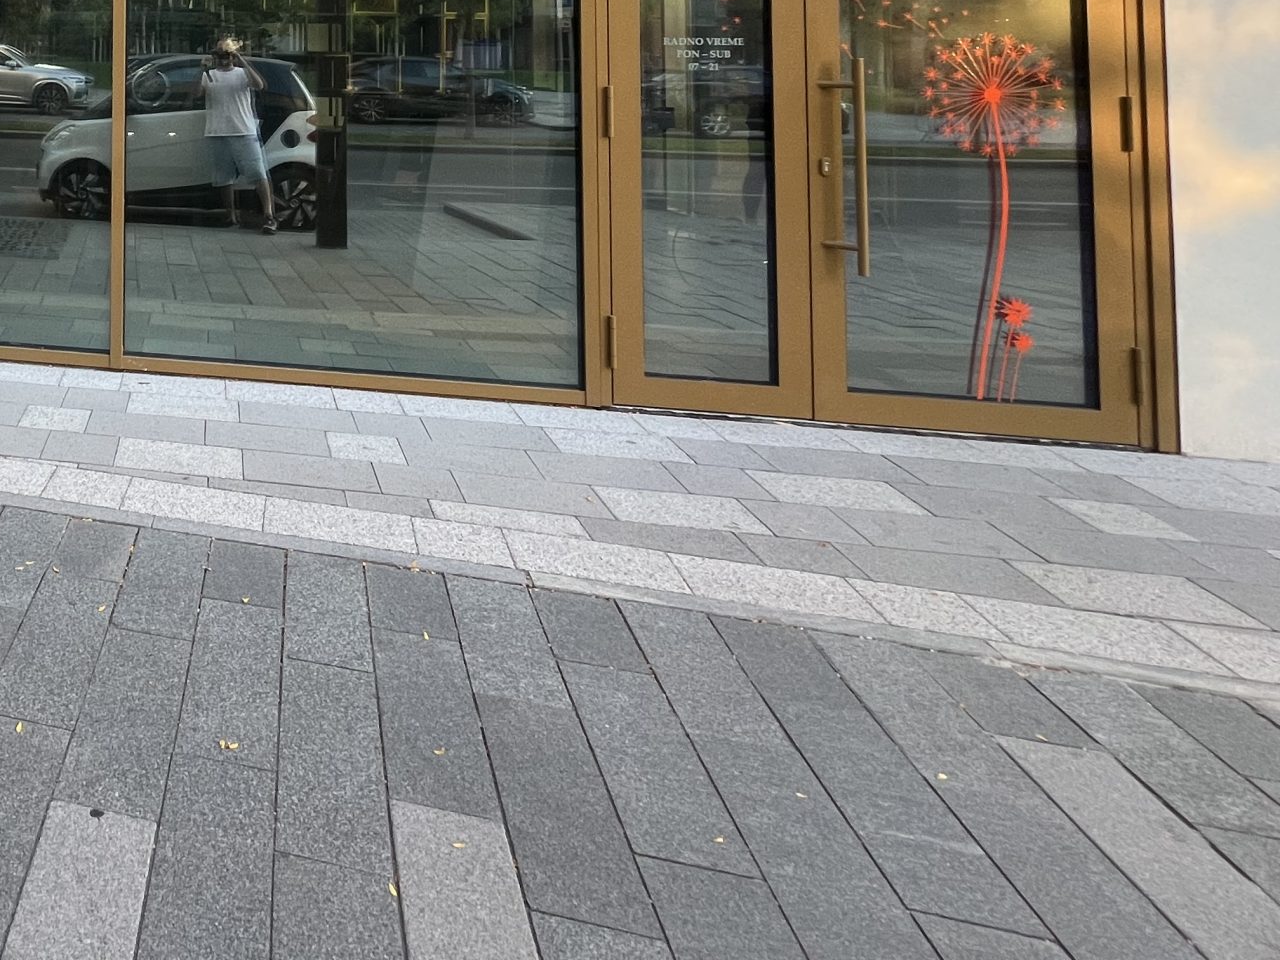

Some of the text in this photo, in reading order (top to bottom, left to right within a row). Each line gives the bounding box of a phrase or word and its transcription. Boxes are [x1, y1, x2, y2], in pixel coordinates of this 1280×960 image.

[663, 37, 745, 46] RADNO VREME
[676, 49, 700, 58] PON
[709, 49, 731, 58] SUB
[708, 62, 719, 71] 21
